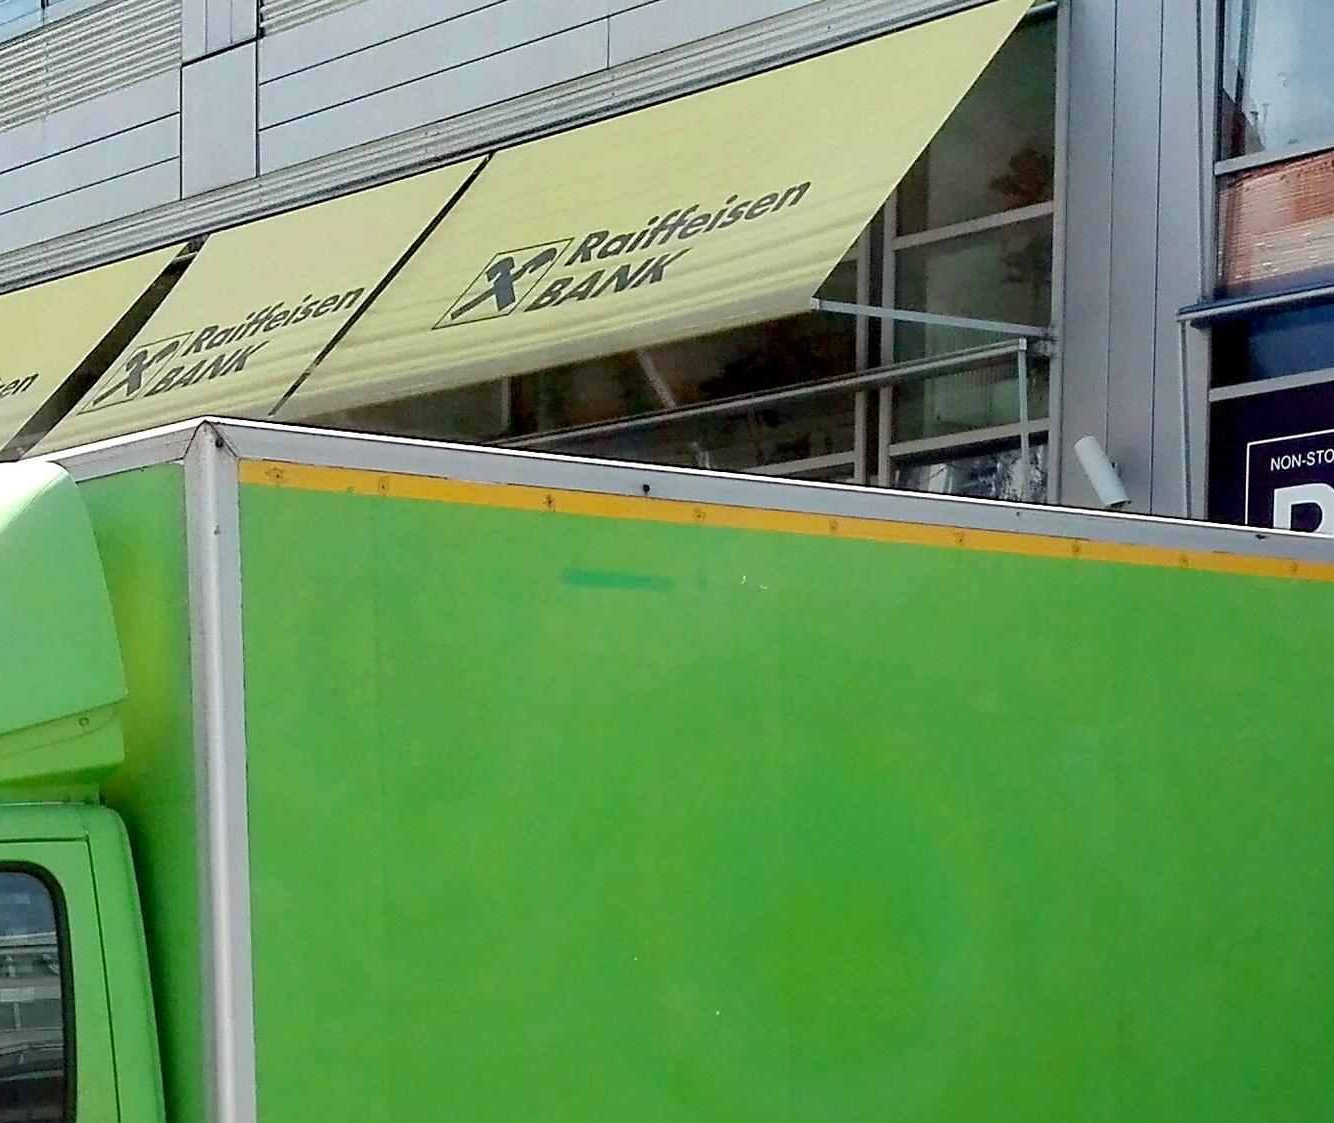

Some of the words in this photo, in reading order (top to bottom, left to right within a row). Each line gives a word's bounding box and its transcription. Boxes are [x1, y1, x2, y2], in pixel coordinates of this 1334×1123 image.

[564, 181, 811, 266] Raiffeisen
[523, 246, 693, 312] BANK
[181, 287, 365, 357] Raiffeisen
[144, 340, 270, 397] BANK
